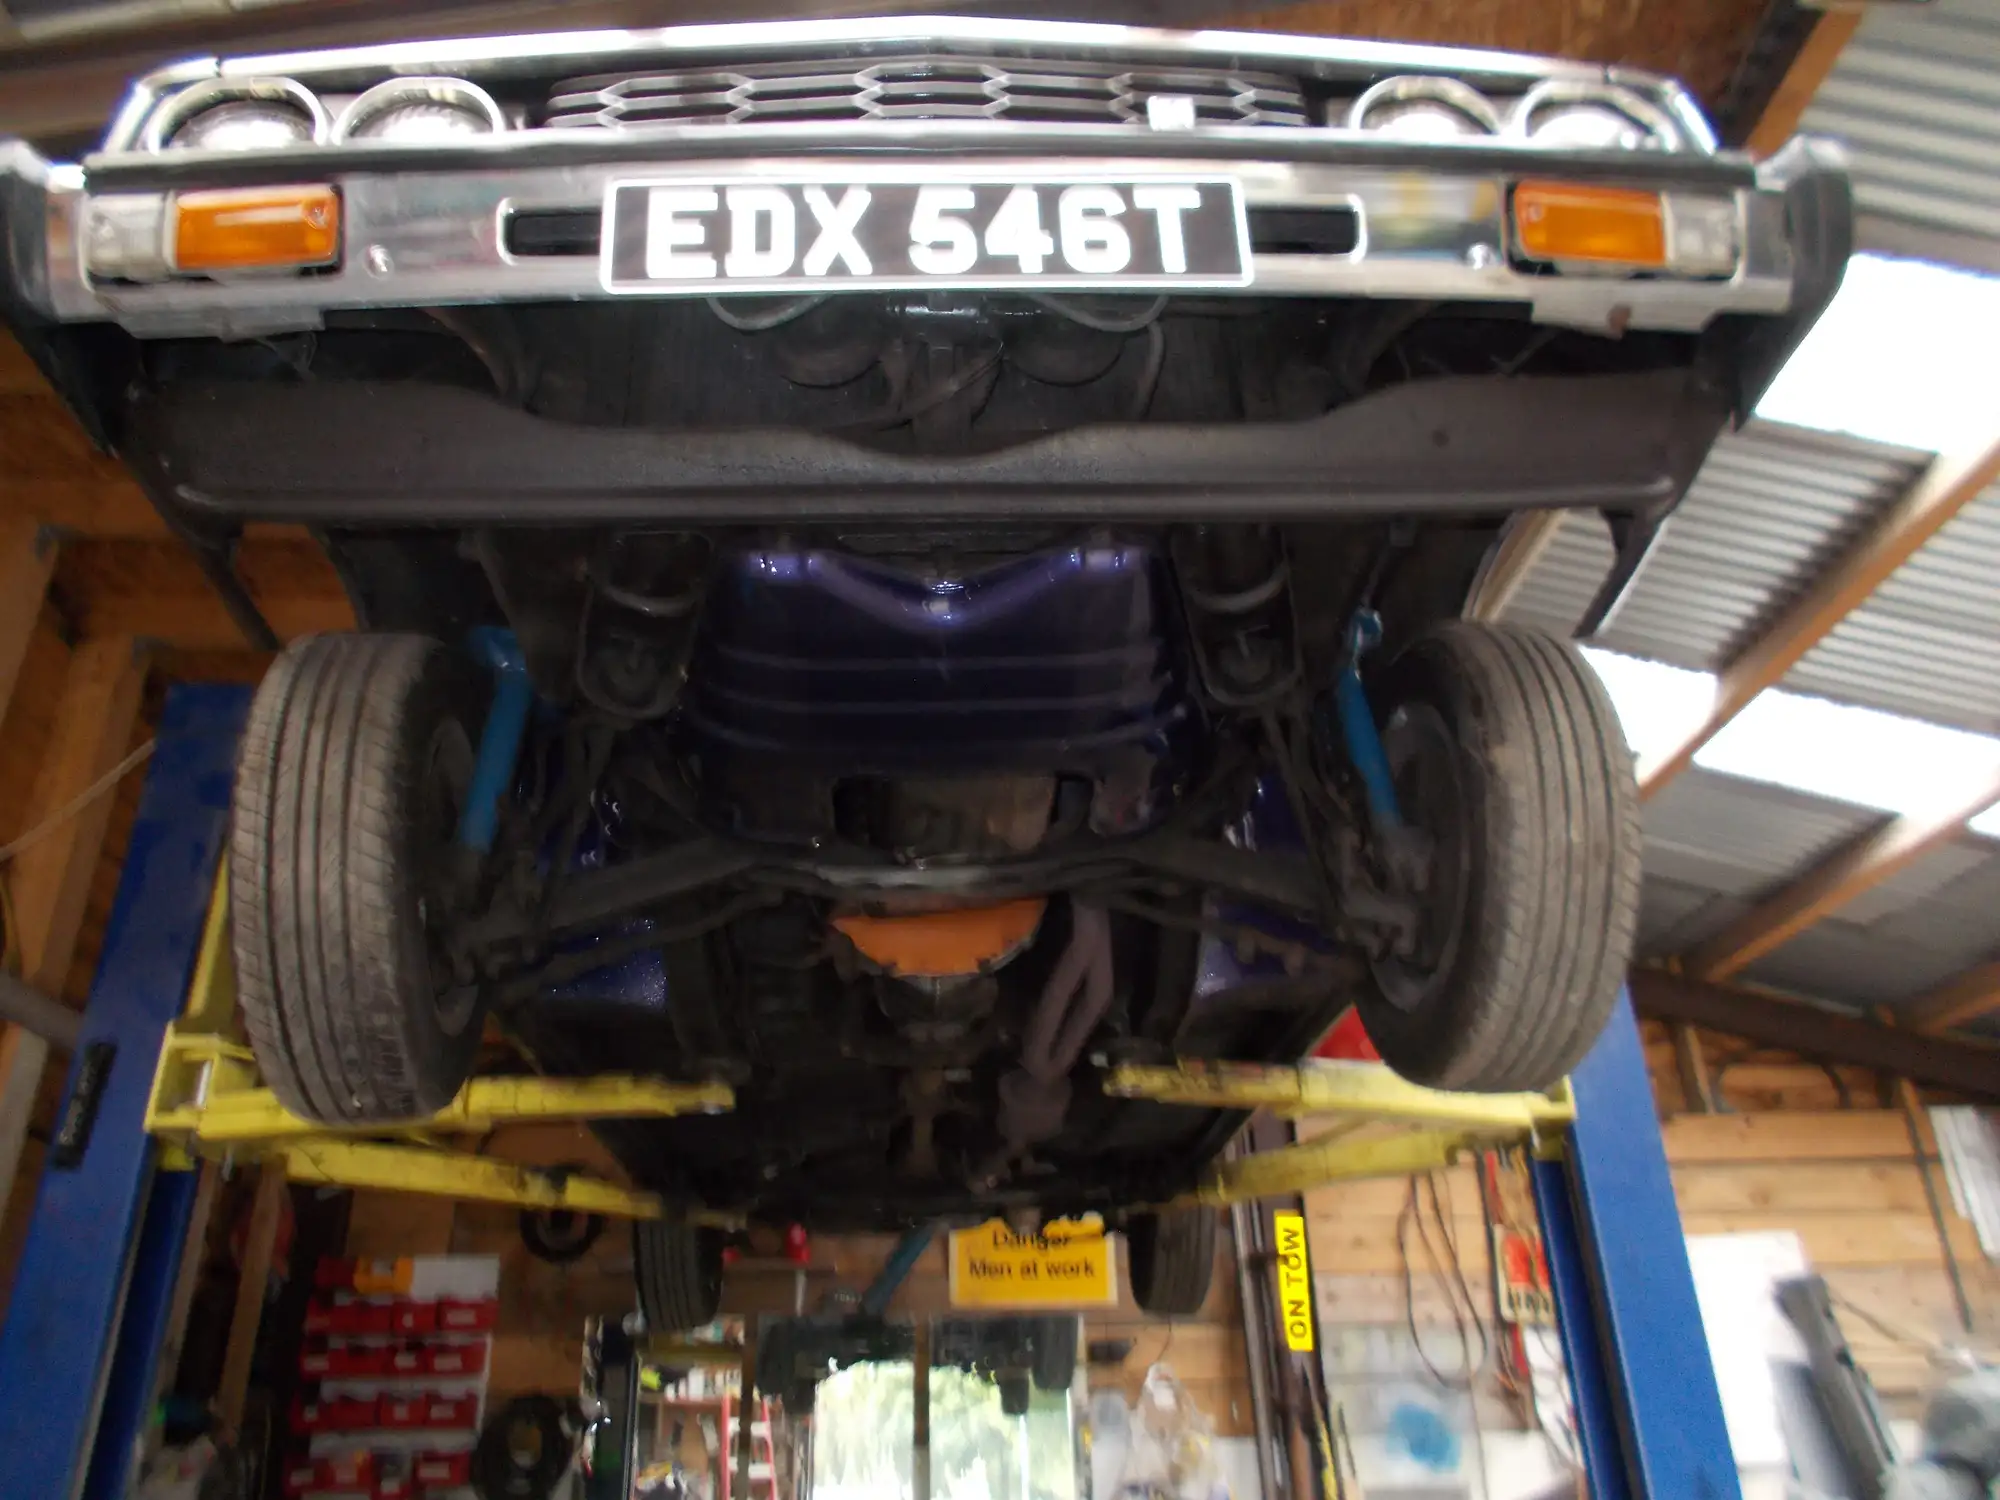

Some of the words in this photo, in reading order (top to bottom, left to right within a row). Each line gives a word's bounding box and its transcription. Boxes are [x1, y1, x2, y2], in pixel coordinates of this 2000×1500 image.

[645, 184, 873, 279] EDX
[908, 183, 1201, 275] 546T
[969, 1257, 1013, 1279] Men
[1020, 1258, 1038, 1279] at
[1045, 1257, 1096, 1279] work
[1282, 1227, 1304, 1288] TOW
[1287, 1299, 1307, 1339] ON
